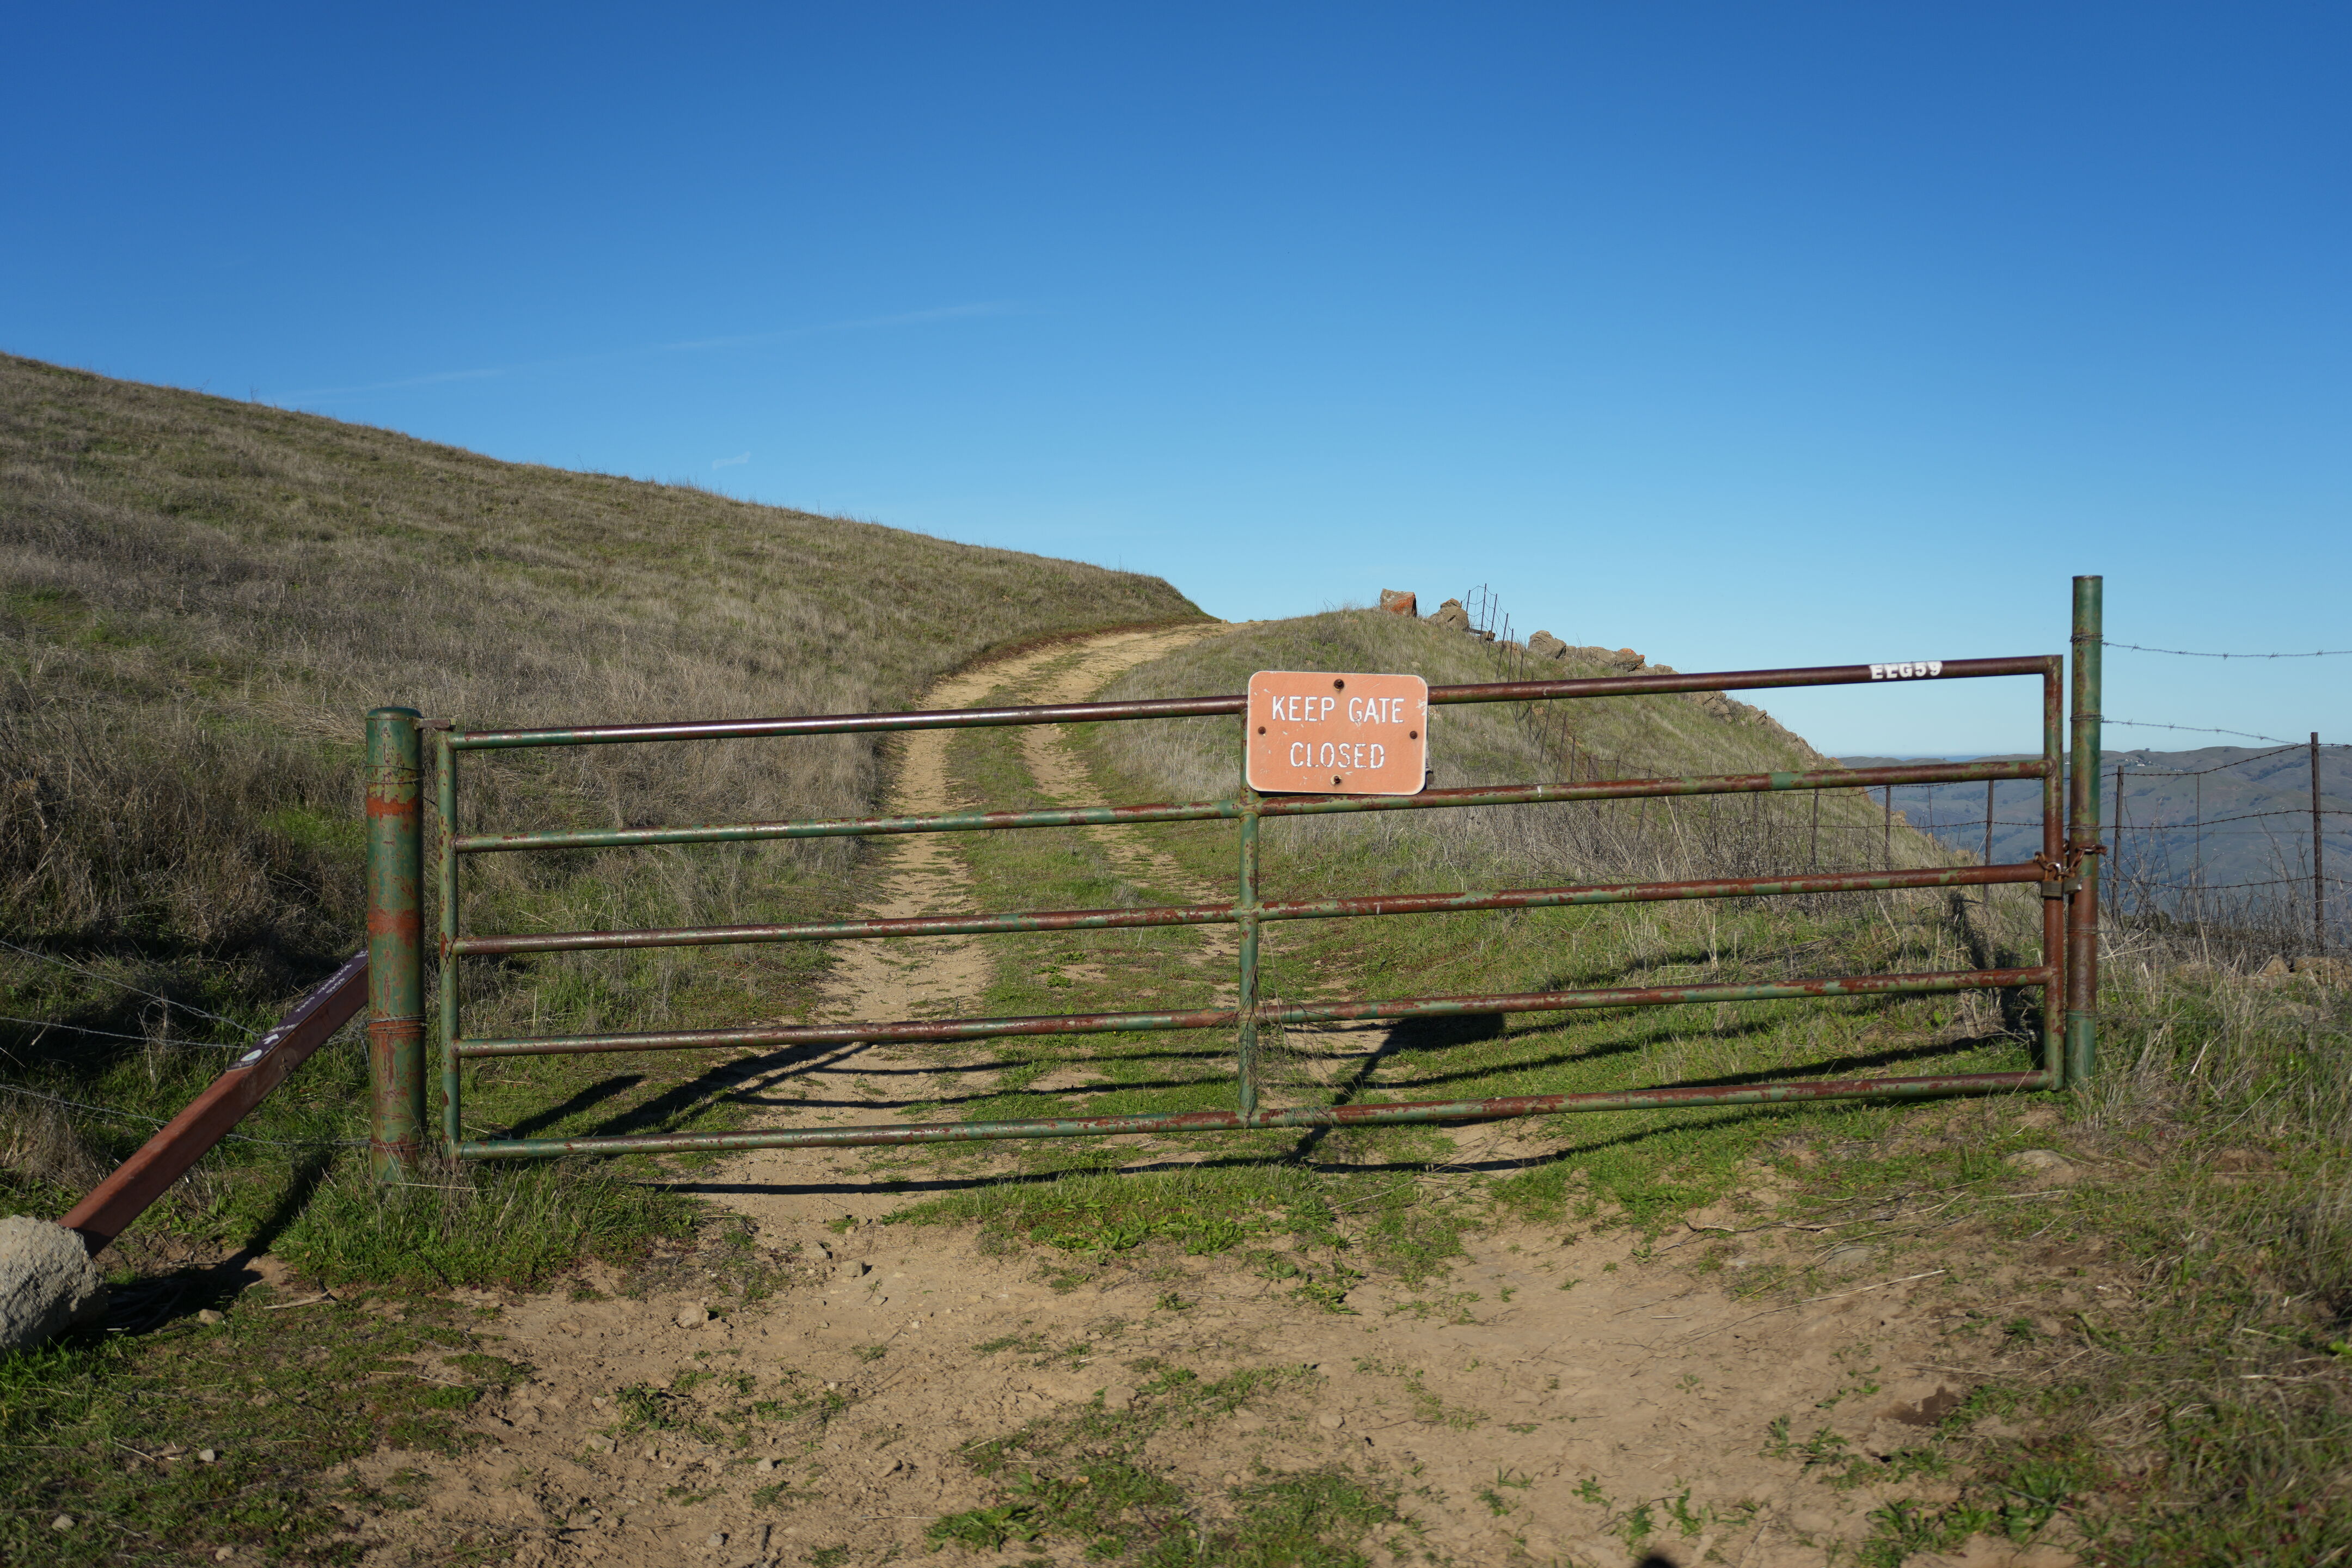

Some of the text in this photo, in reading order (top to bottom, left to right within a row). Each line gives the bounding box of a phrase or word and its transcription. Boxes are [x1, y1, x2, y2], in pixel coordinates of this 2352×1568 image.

[1272, 695, 1405, 724] KEEP GATE
[1290, 742, 1385, 768] CLOSED
